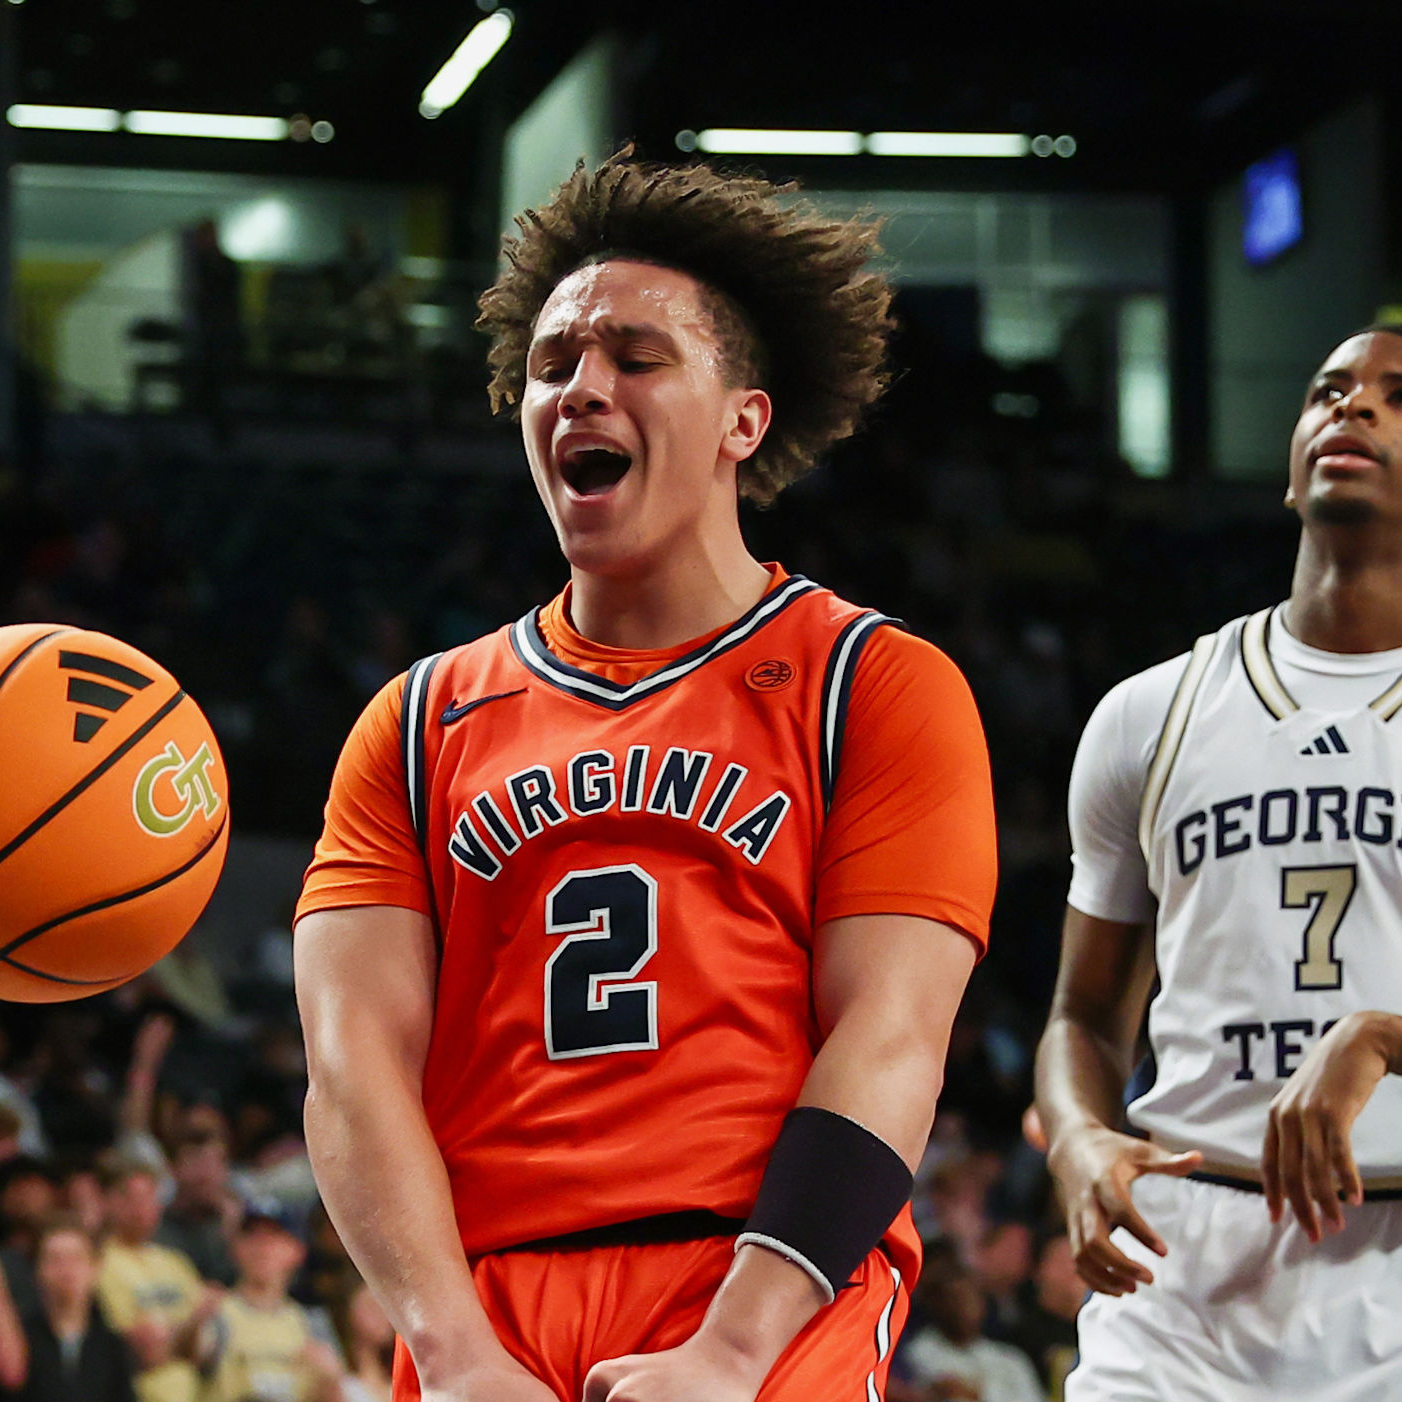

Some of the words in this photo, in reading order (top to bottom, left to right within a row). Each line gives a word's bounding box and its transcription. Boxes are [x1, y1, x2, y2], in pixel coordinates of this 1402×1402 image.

[448, 745, 791, 881] VIRGINIA
[544, 863, 659, 1061] 2
[1279, 863, 1359, 991] 7
[1221, 1018, 1340, 1081] TE
